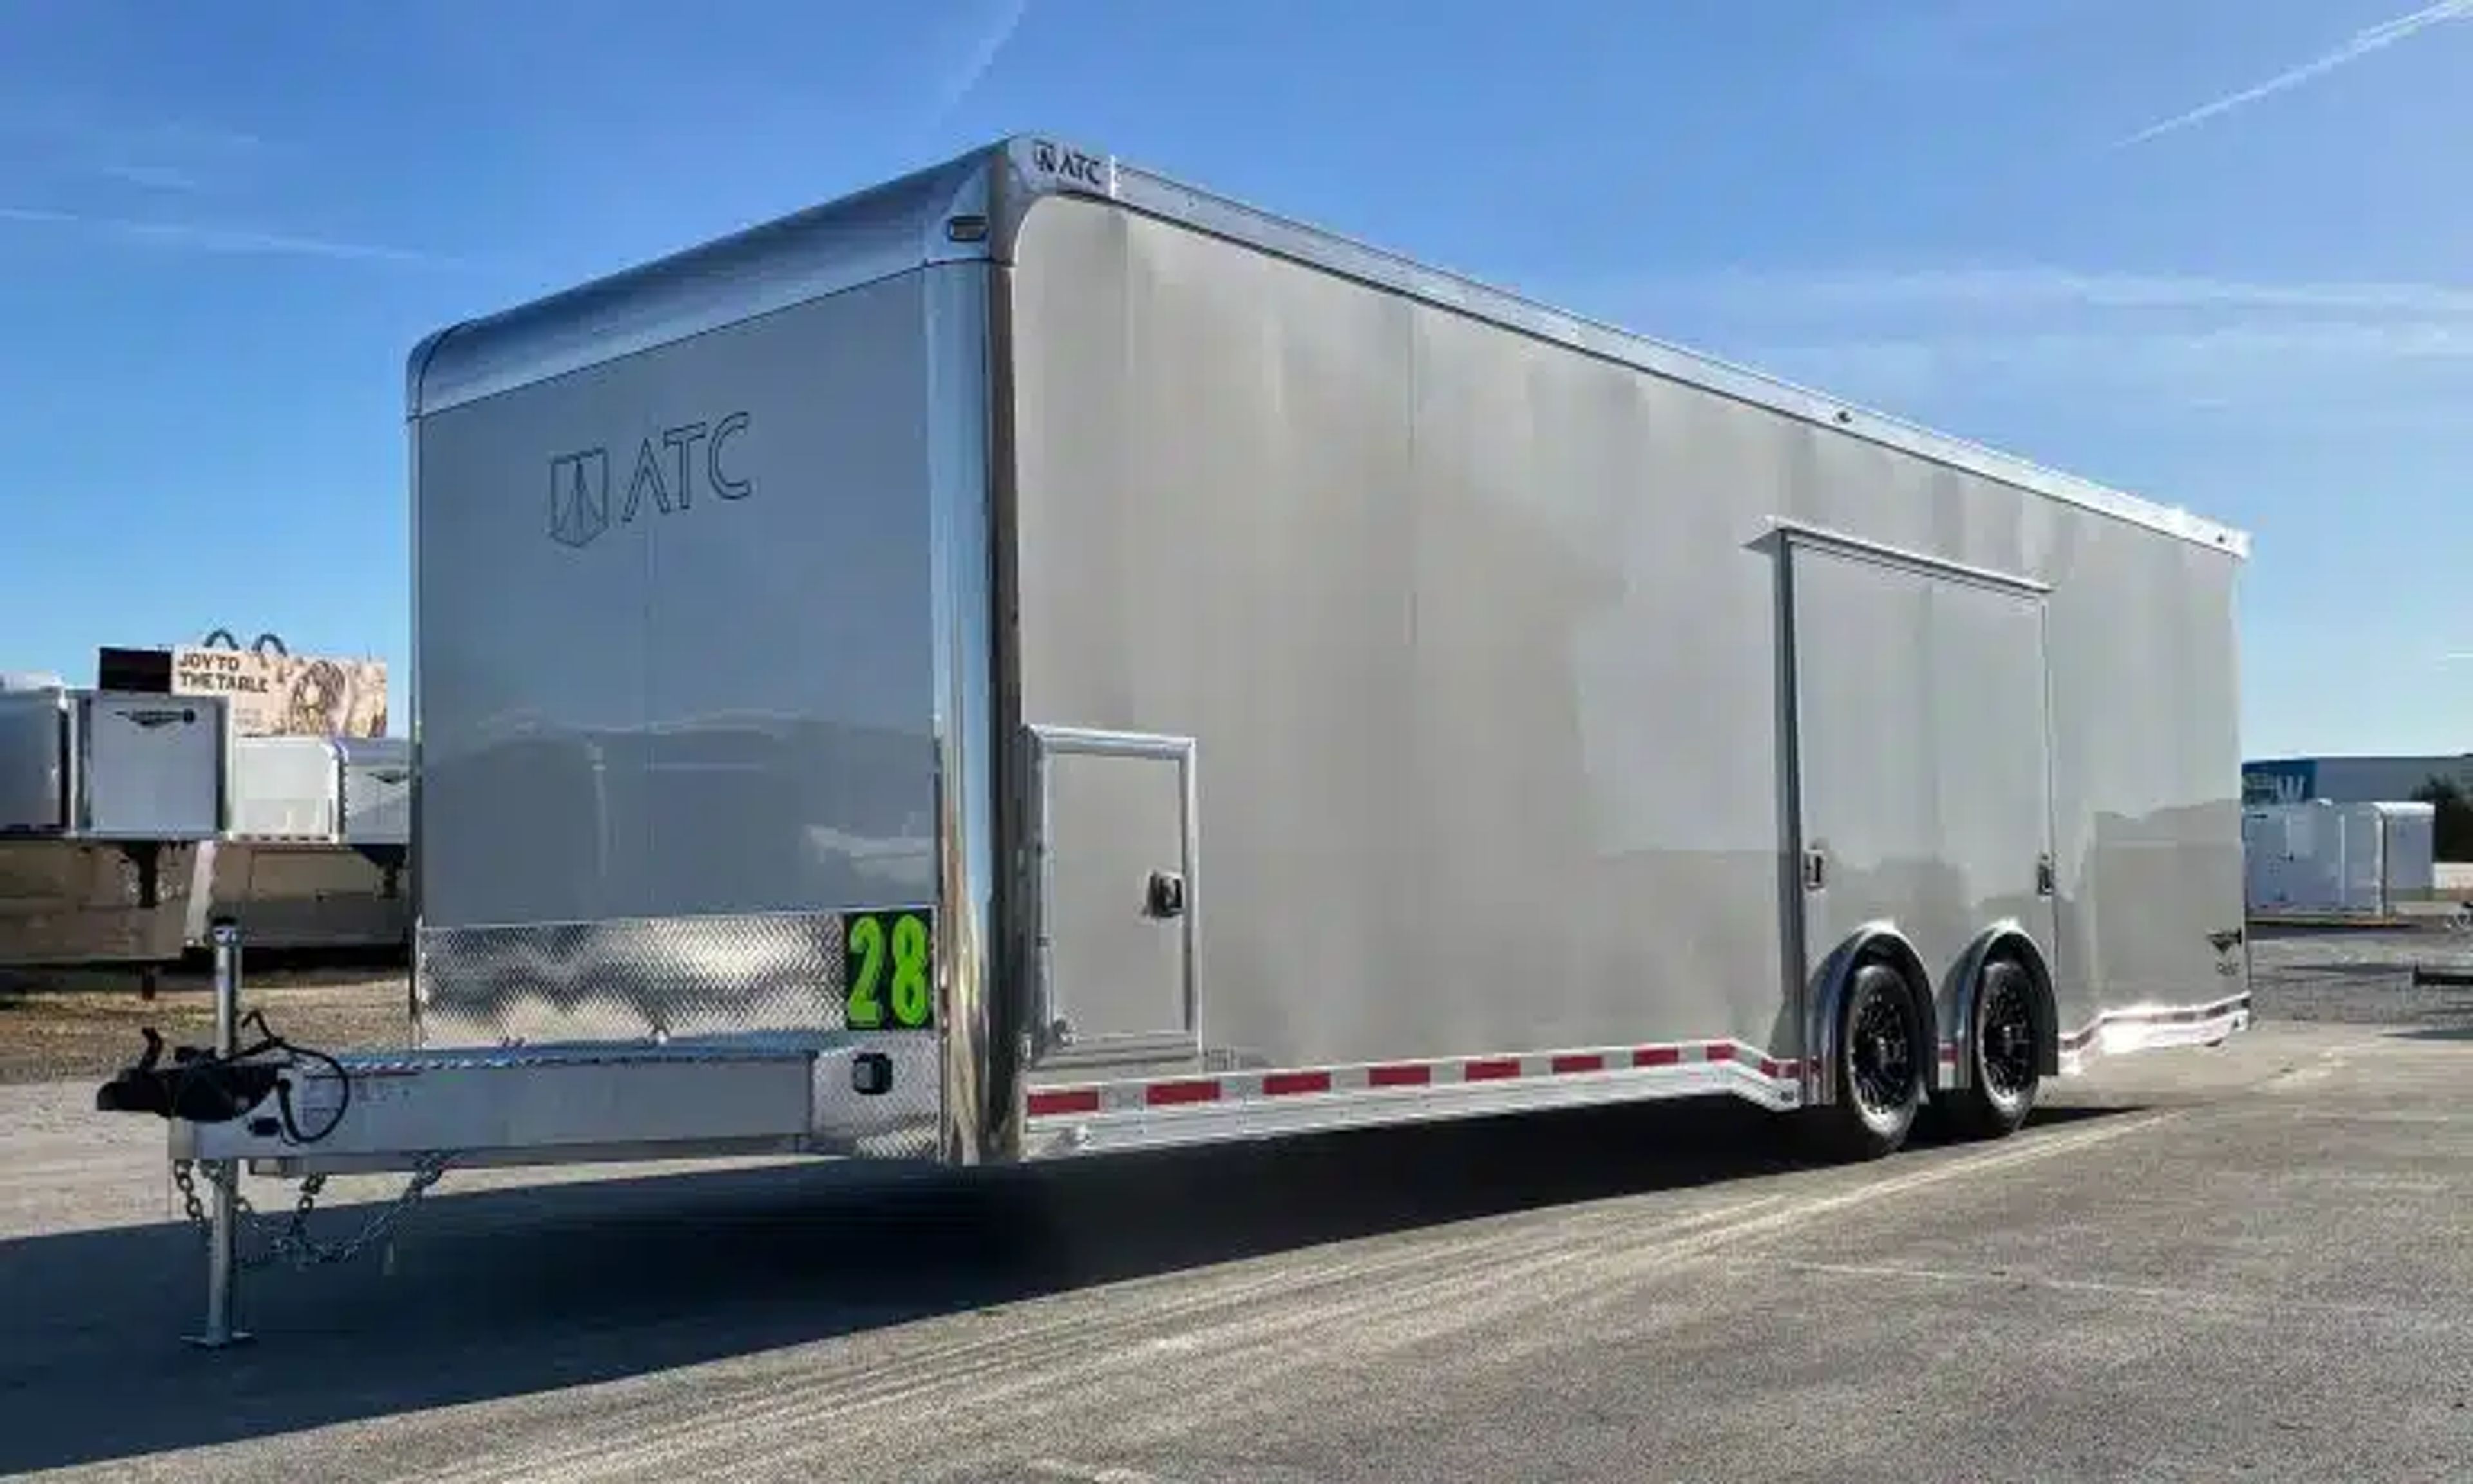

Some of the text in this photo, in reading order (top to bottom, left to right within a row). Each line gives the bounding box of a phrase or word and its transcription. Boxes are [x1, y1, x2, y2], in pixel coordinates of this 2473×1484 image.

[1059, 154, 1099, 185] ATC
[622, 411, 752, 523] ATC
[179, 653, 240, 671] JOY TO
[180, 671, 269, 693] THE TABLE
[847, 913, 929, 1028] 28
